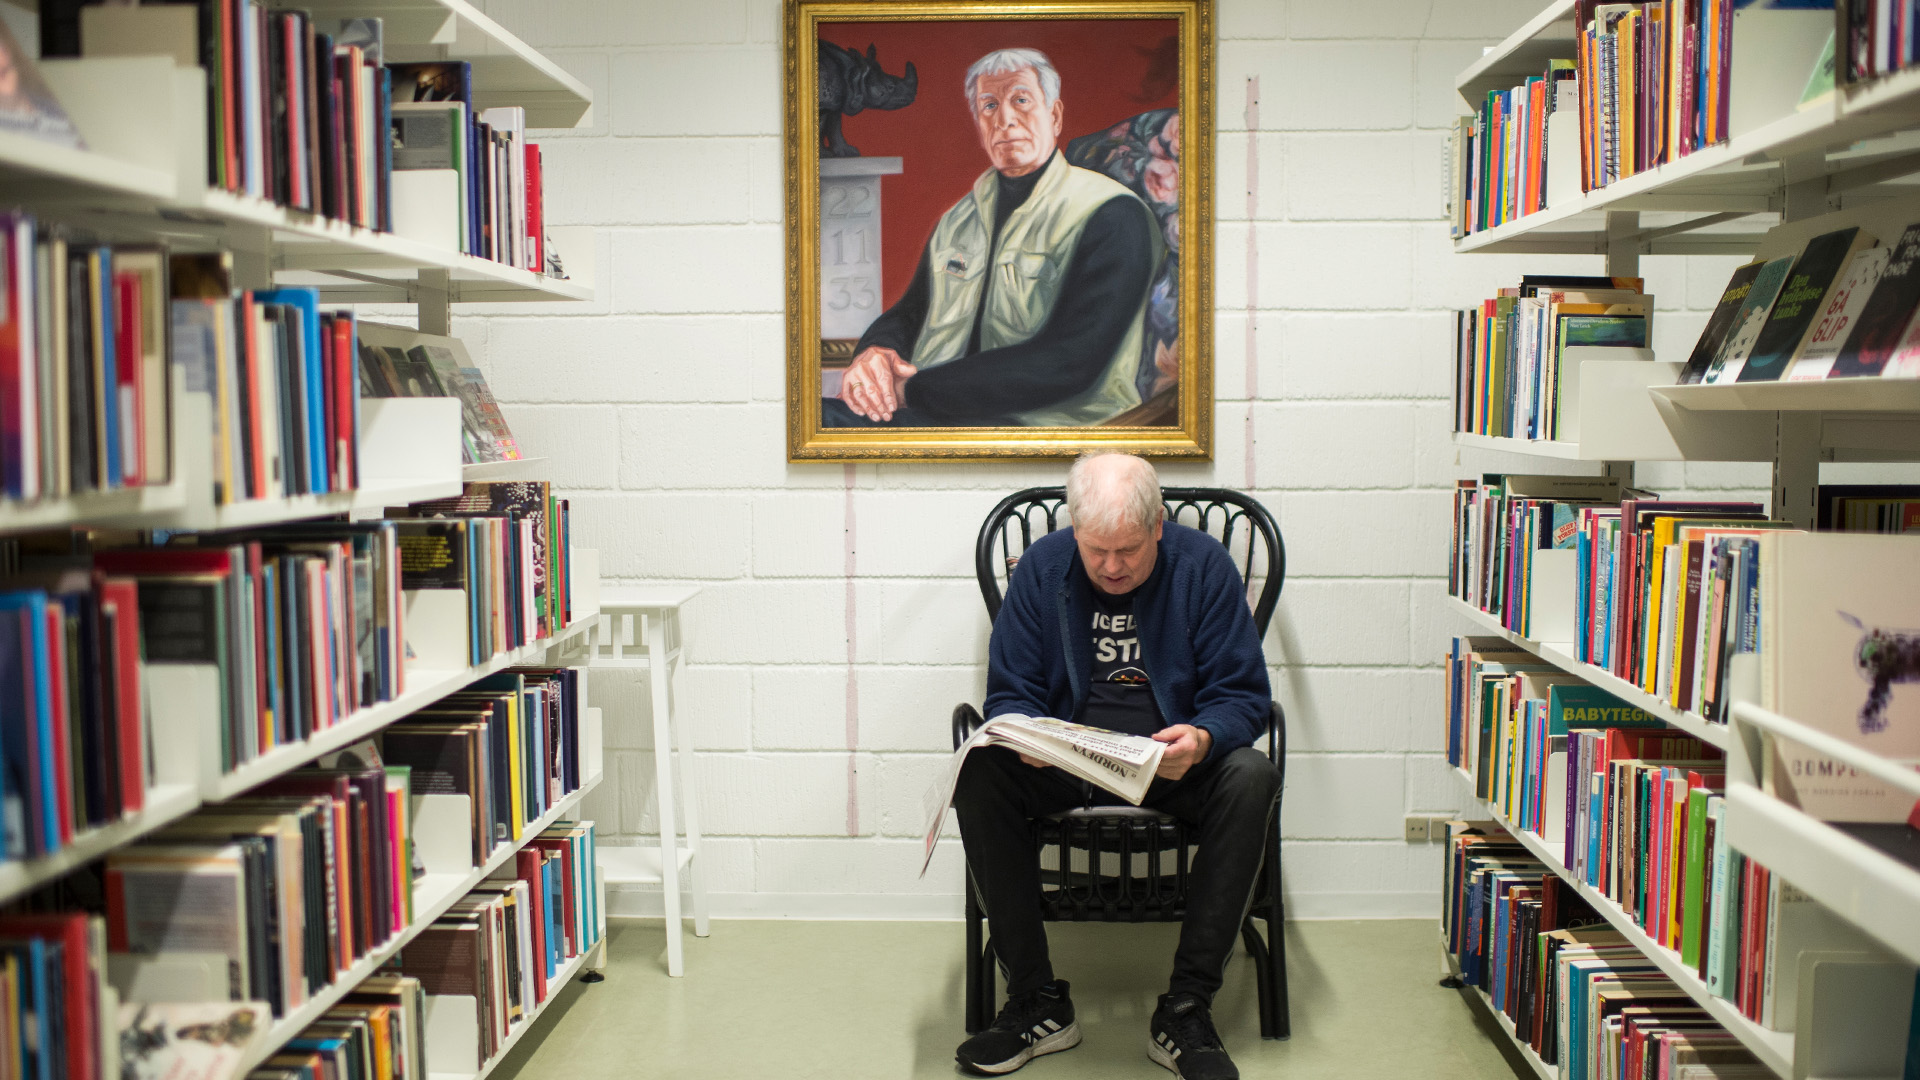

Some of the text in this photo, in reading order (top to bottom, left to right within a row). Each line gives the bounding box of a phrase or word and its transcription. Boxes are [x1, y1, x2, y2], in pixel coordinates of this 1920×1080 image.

[827, 186, 871, 219] 22
[832, 229, 870, 265] 11
[827, 276, 875, 311] 33
[1812, 316, 1848, 343] GLIP
